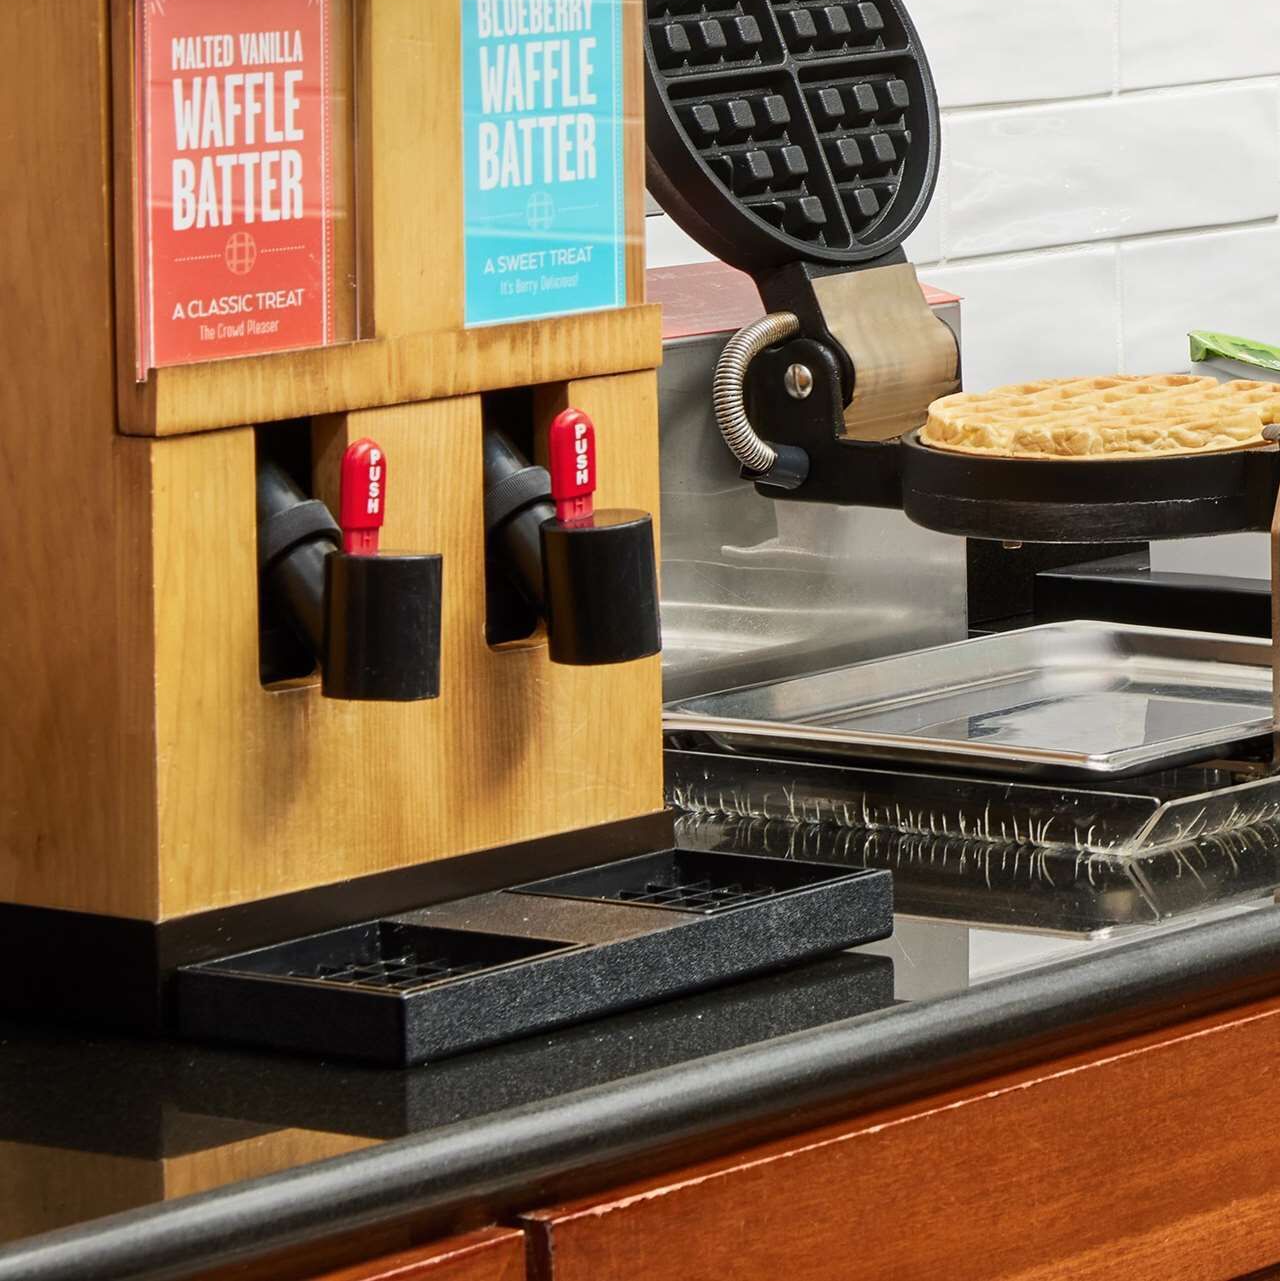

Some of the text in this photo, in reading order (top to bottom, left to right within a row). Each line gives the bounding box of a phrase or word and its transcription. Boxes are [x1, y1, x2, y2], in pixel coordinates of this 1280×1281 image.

[172, 30, 304, 71] MALTED VANILLA
[479, 36, 597, 114] WAFFLE
[172, 70, 304, 151] WAFFLE
[478, 112, 597, 191] BATTER
[172, 148, 304, 231] BATTER
[483, 245, 594, 275] A SWEET TREAT
[172, 288, 305, 320] A CLASSIC TREAT
[199, 319, 280, 340] The Crowd Pleaser
[368, 448, 381, 514] PUSH
[574, 423, 589, 486] PUSH
